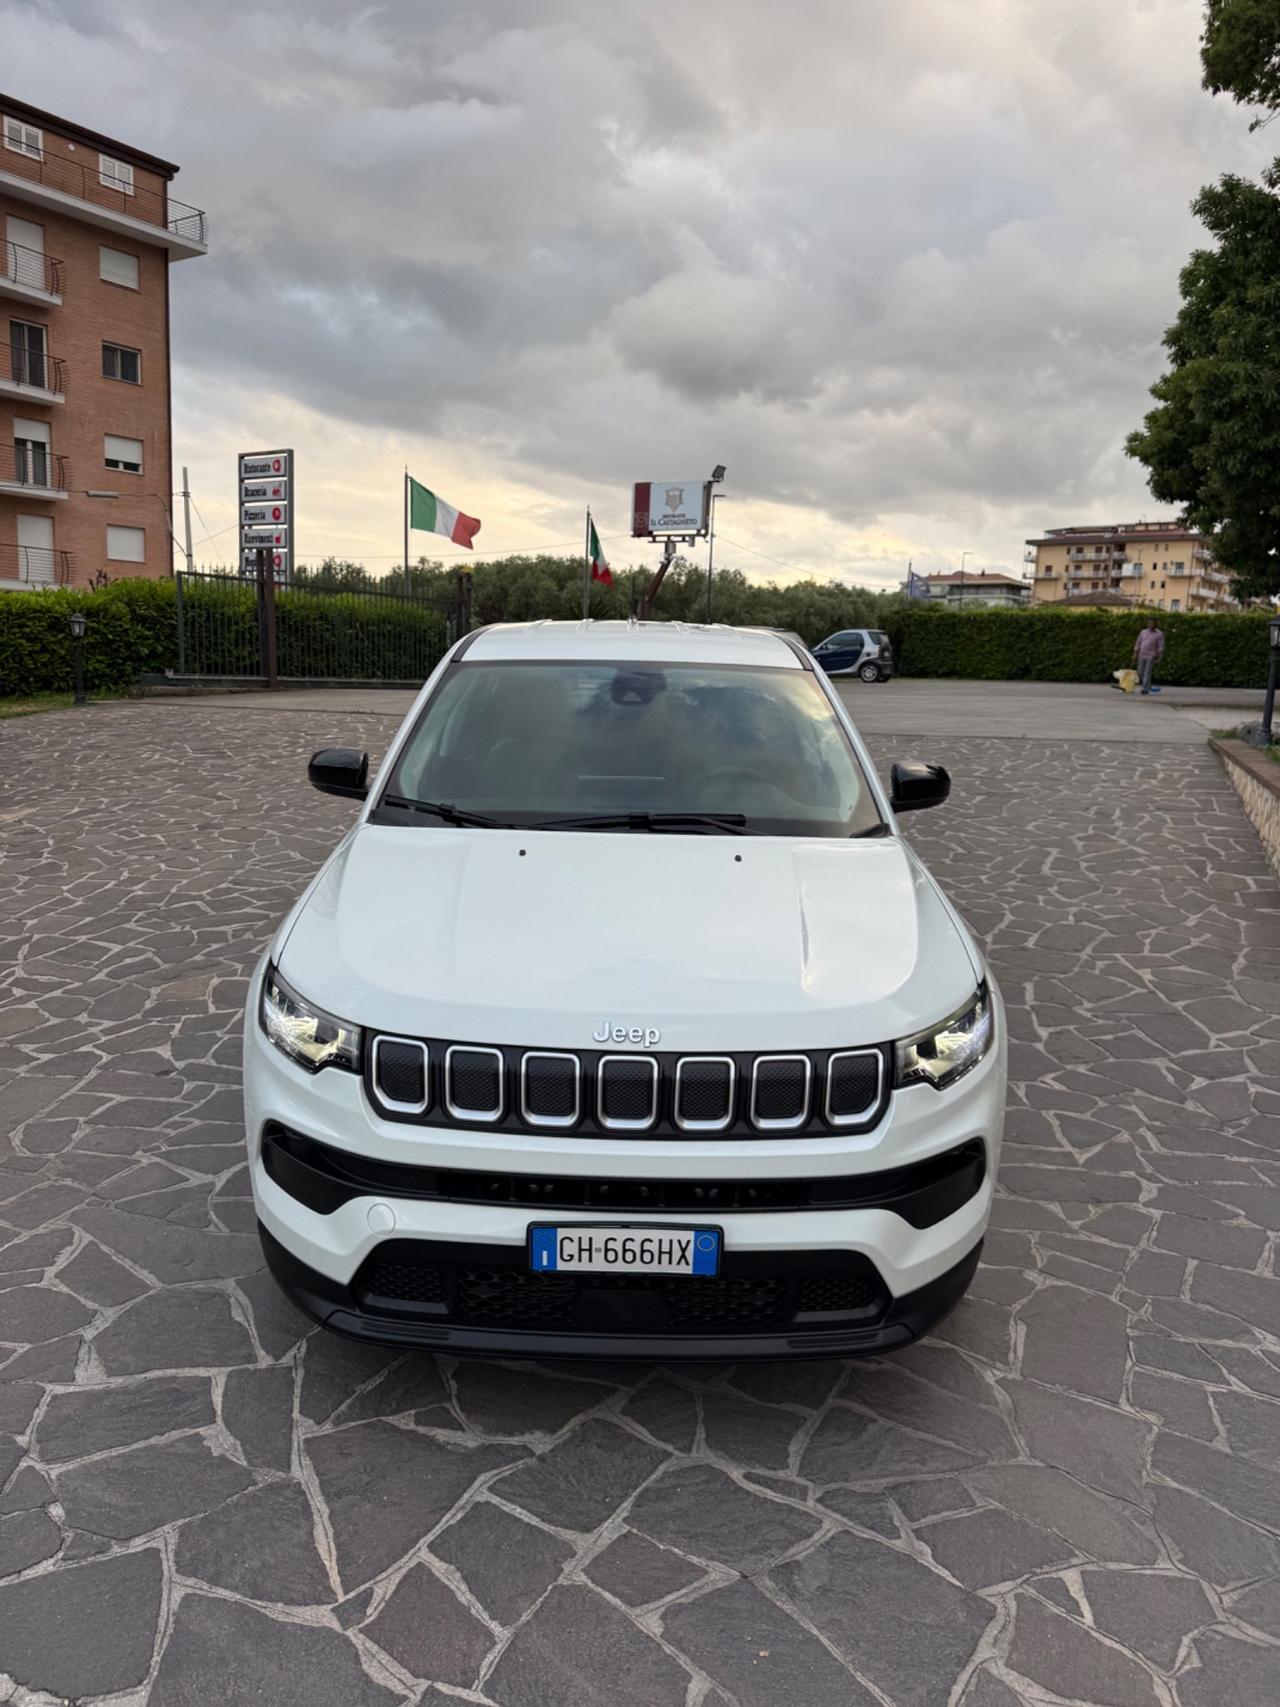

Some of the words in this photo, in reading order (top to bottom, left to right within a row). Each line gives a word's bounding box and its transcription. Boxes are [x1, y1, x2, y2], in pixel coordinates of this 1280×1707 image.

[243, 463, 271, 474] Ristorante
[244, 509, 266, 521] Pizzeria
[592, 1021, 660, 1048] Jeep
